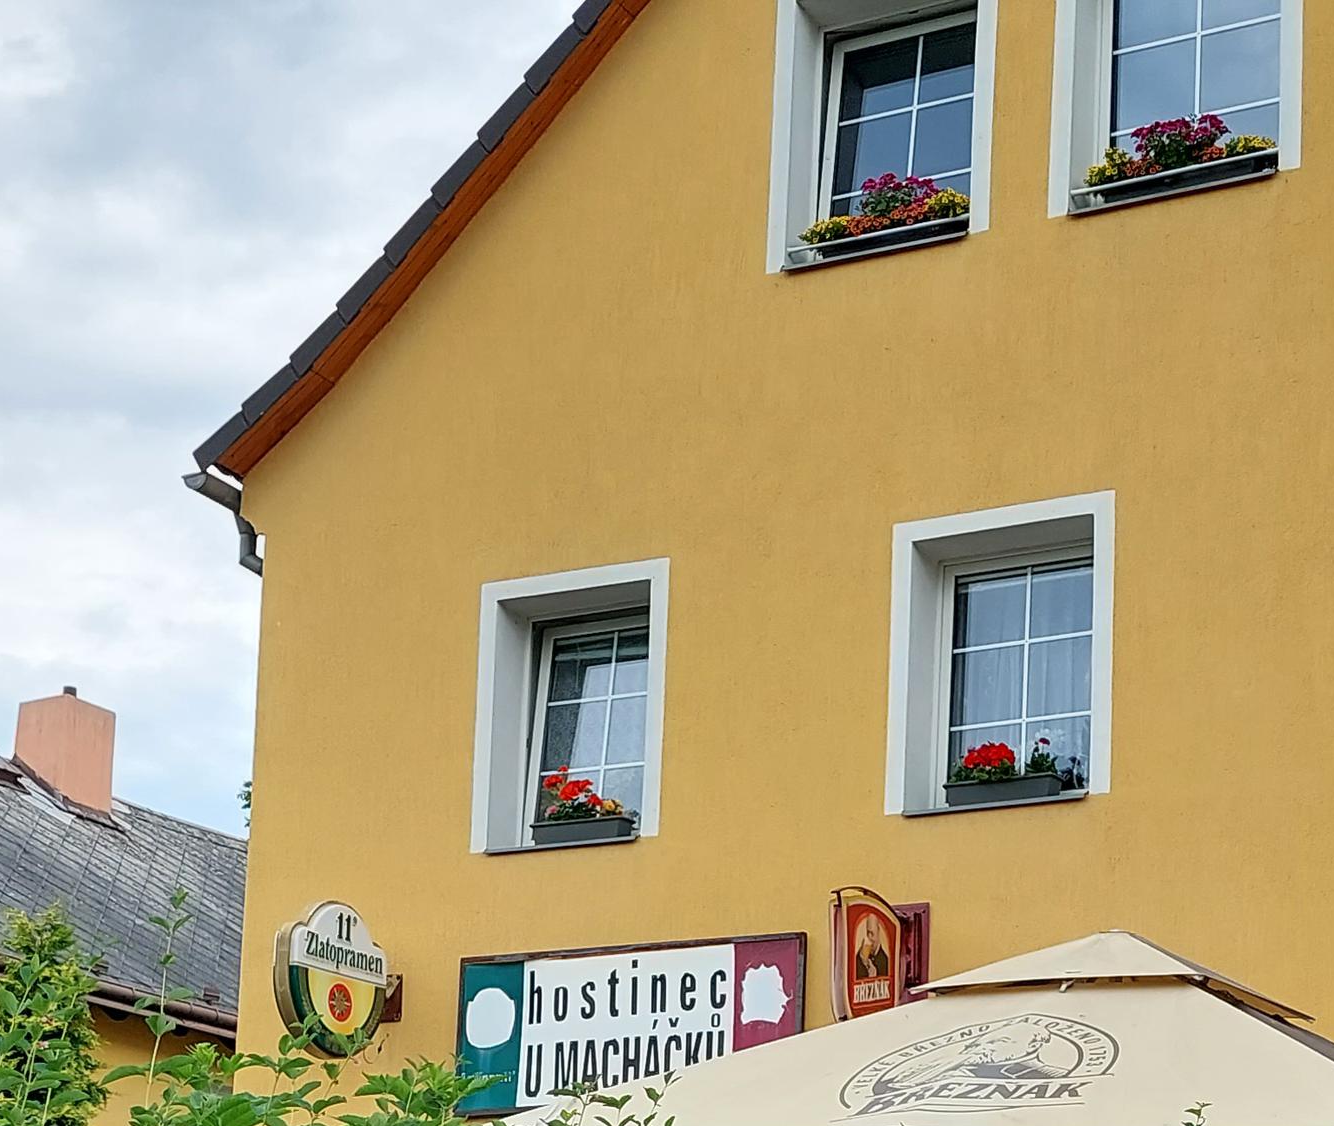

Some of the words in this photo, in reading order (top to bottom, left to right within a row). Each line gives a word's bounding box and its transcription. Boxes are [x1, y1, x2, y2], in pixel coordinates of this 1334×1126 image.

[304, 931, 384, 975] Zlatopramen
[528, 959, 727, 1025] hostinec
[525, 1043, 542, 1098] U
[554, 1013, 725, 1096] MACHÁČKŮ
